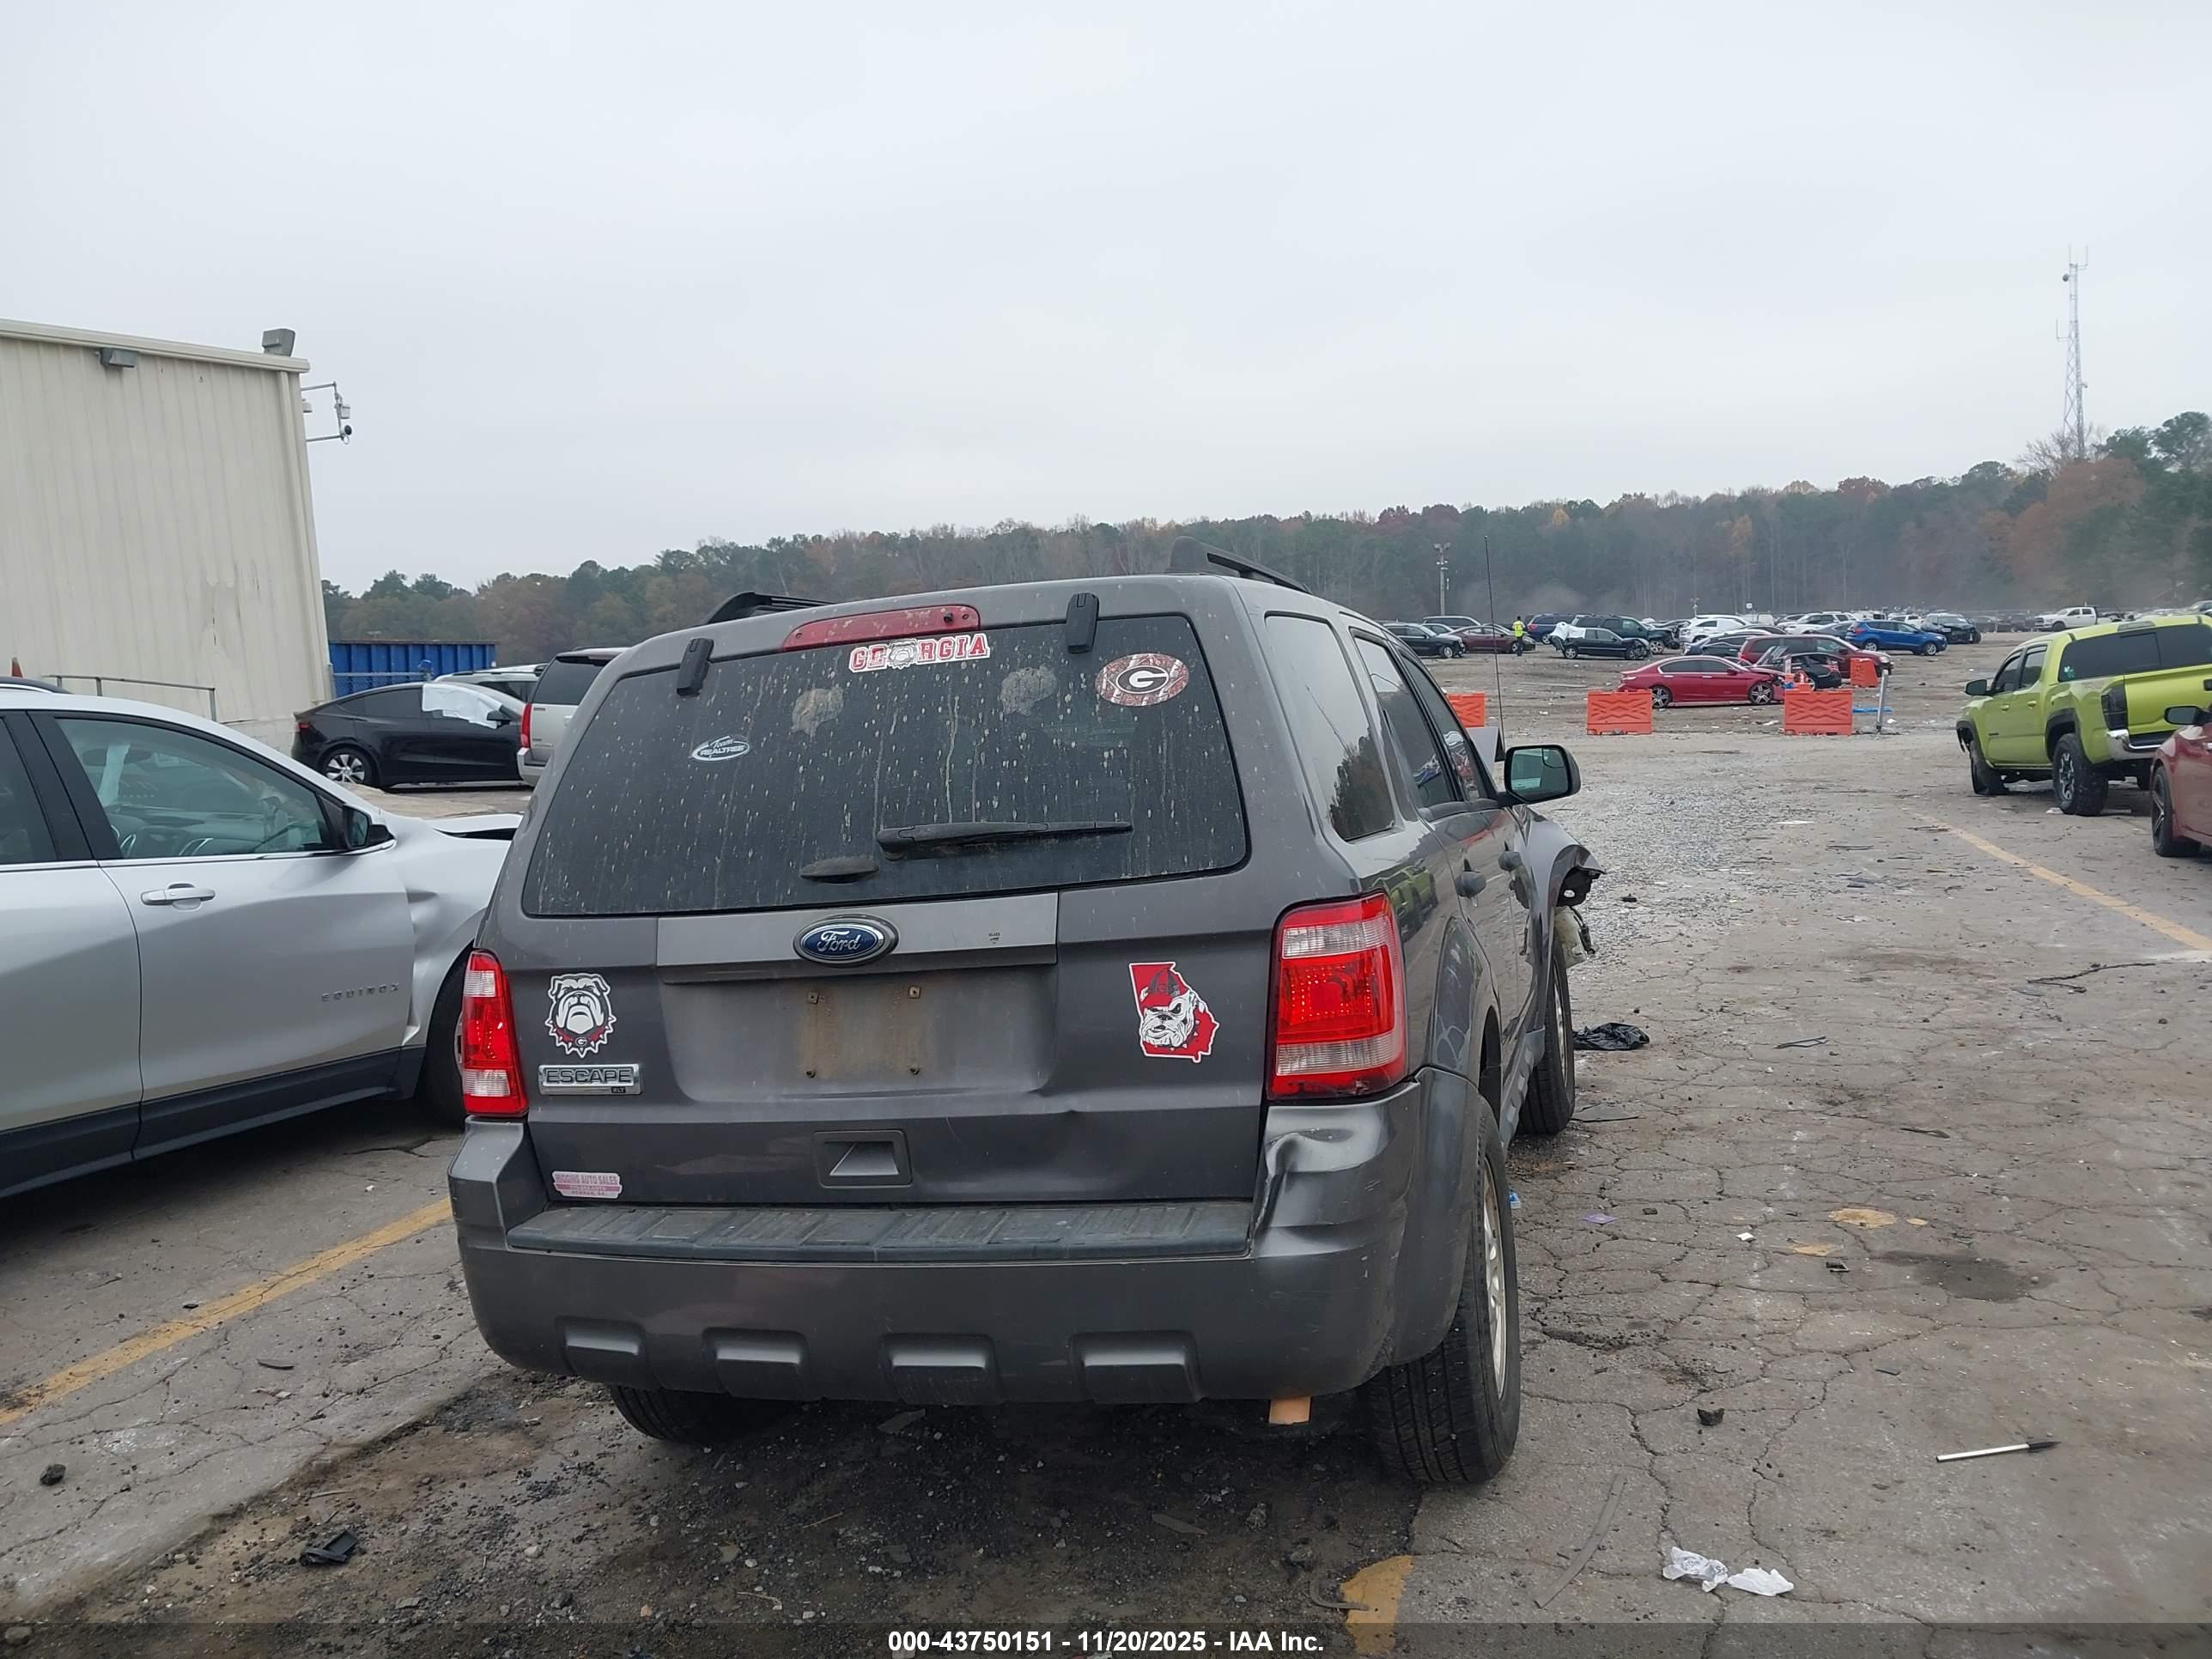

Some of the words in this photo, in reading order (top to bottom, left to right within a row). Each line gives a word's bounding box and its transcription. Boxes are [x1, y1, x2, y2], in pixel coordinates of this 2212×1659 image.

[1127, 669, 1169, 689] G
[817, 930, 861, 951] Ford
[321, 982, 398, 1002] EQUINOX
[546, 1068, 633, 1084] ESCAPE
[581, 1174, 598, 1184] AUTO
[599, 1175, 618, 1185] SALES
